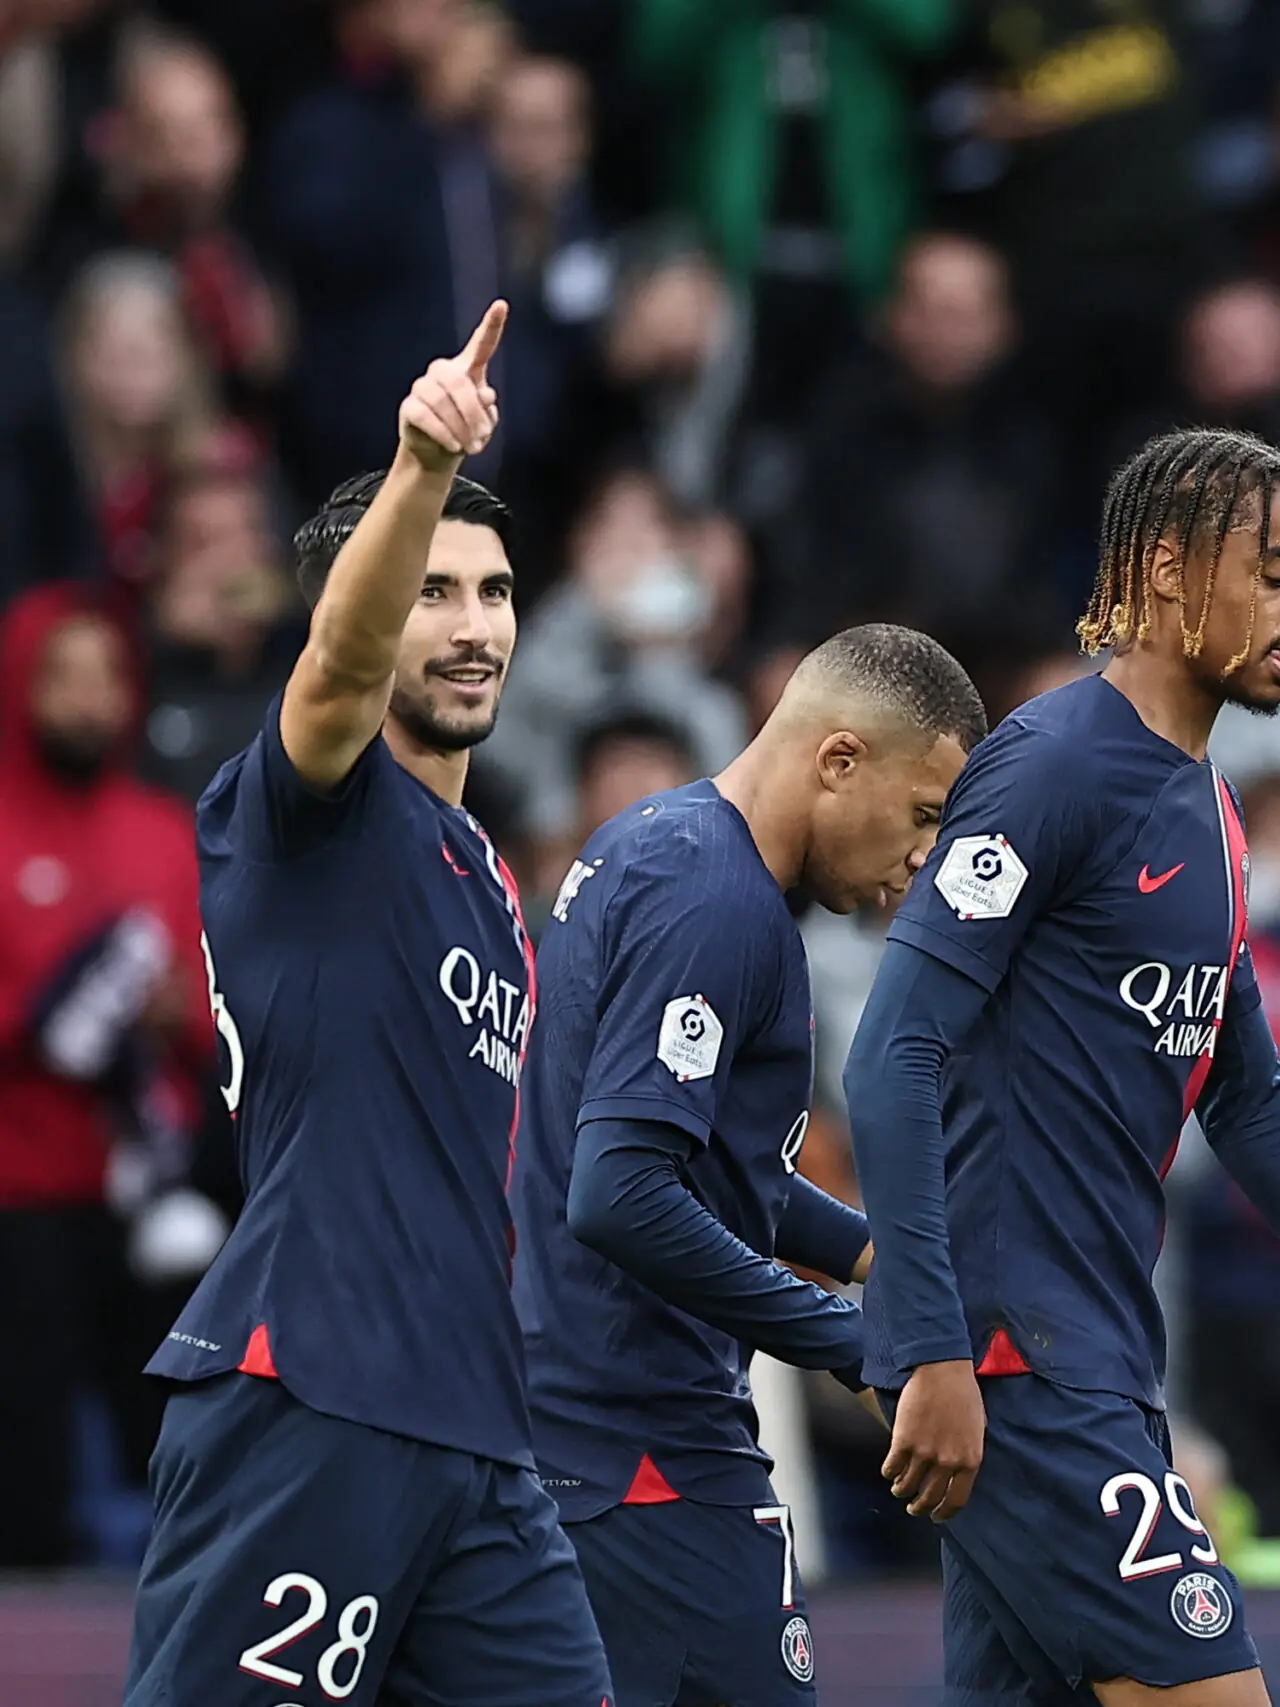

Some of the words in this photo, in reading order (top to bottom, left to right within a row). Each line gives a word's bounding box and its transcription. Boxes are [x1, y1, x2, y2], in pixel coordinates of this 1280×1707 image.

[439, 946, 536, 1053] QATA
[1119, 961, 1228, 1028] QATA
[468, 1027, 522, 1089] AIRW
[753, 1505, 794, 1611] 7
[1100, 1472, 1220, 1582] 29
[238, 1572, 380, 1700] 28
[1177, 1576, 1215, 1596] PARIS
